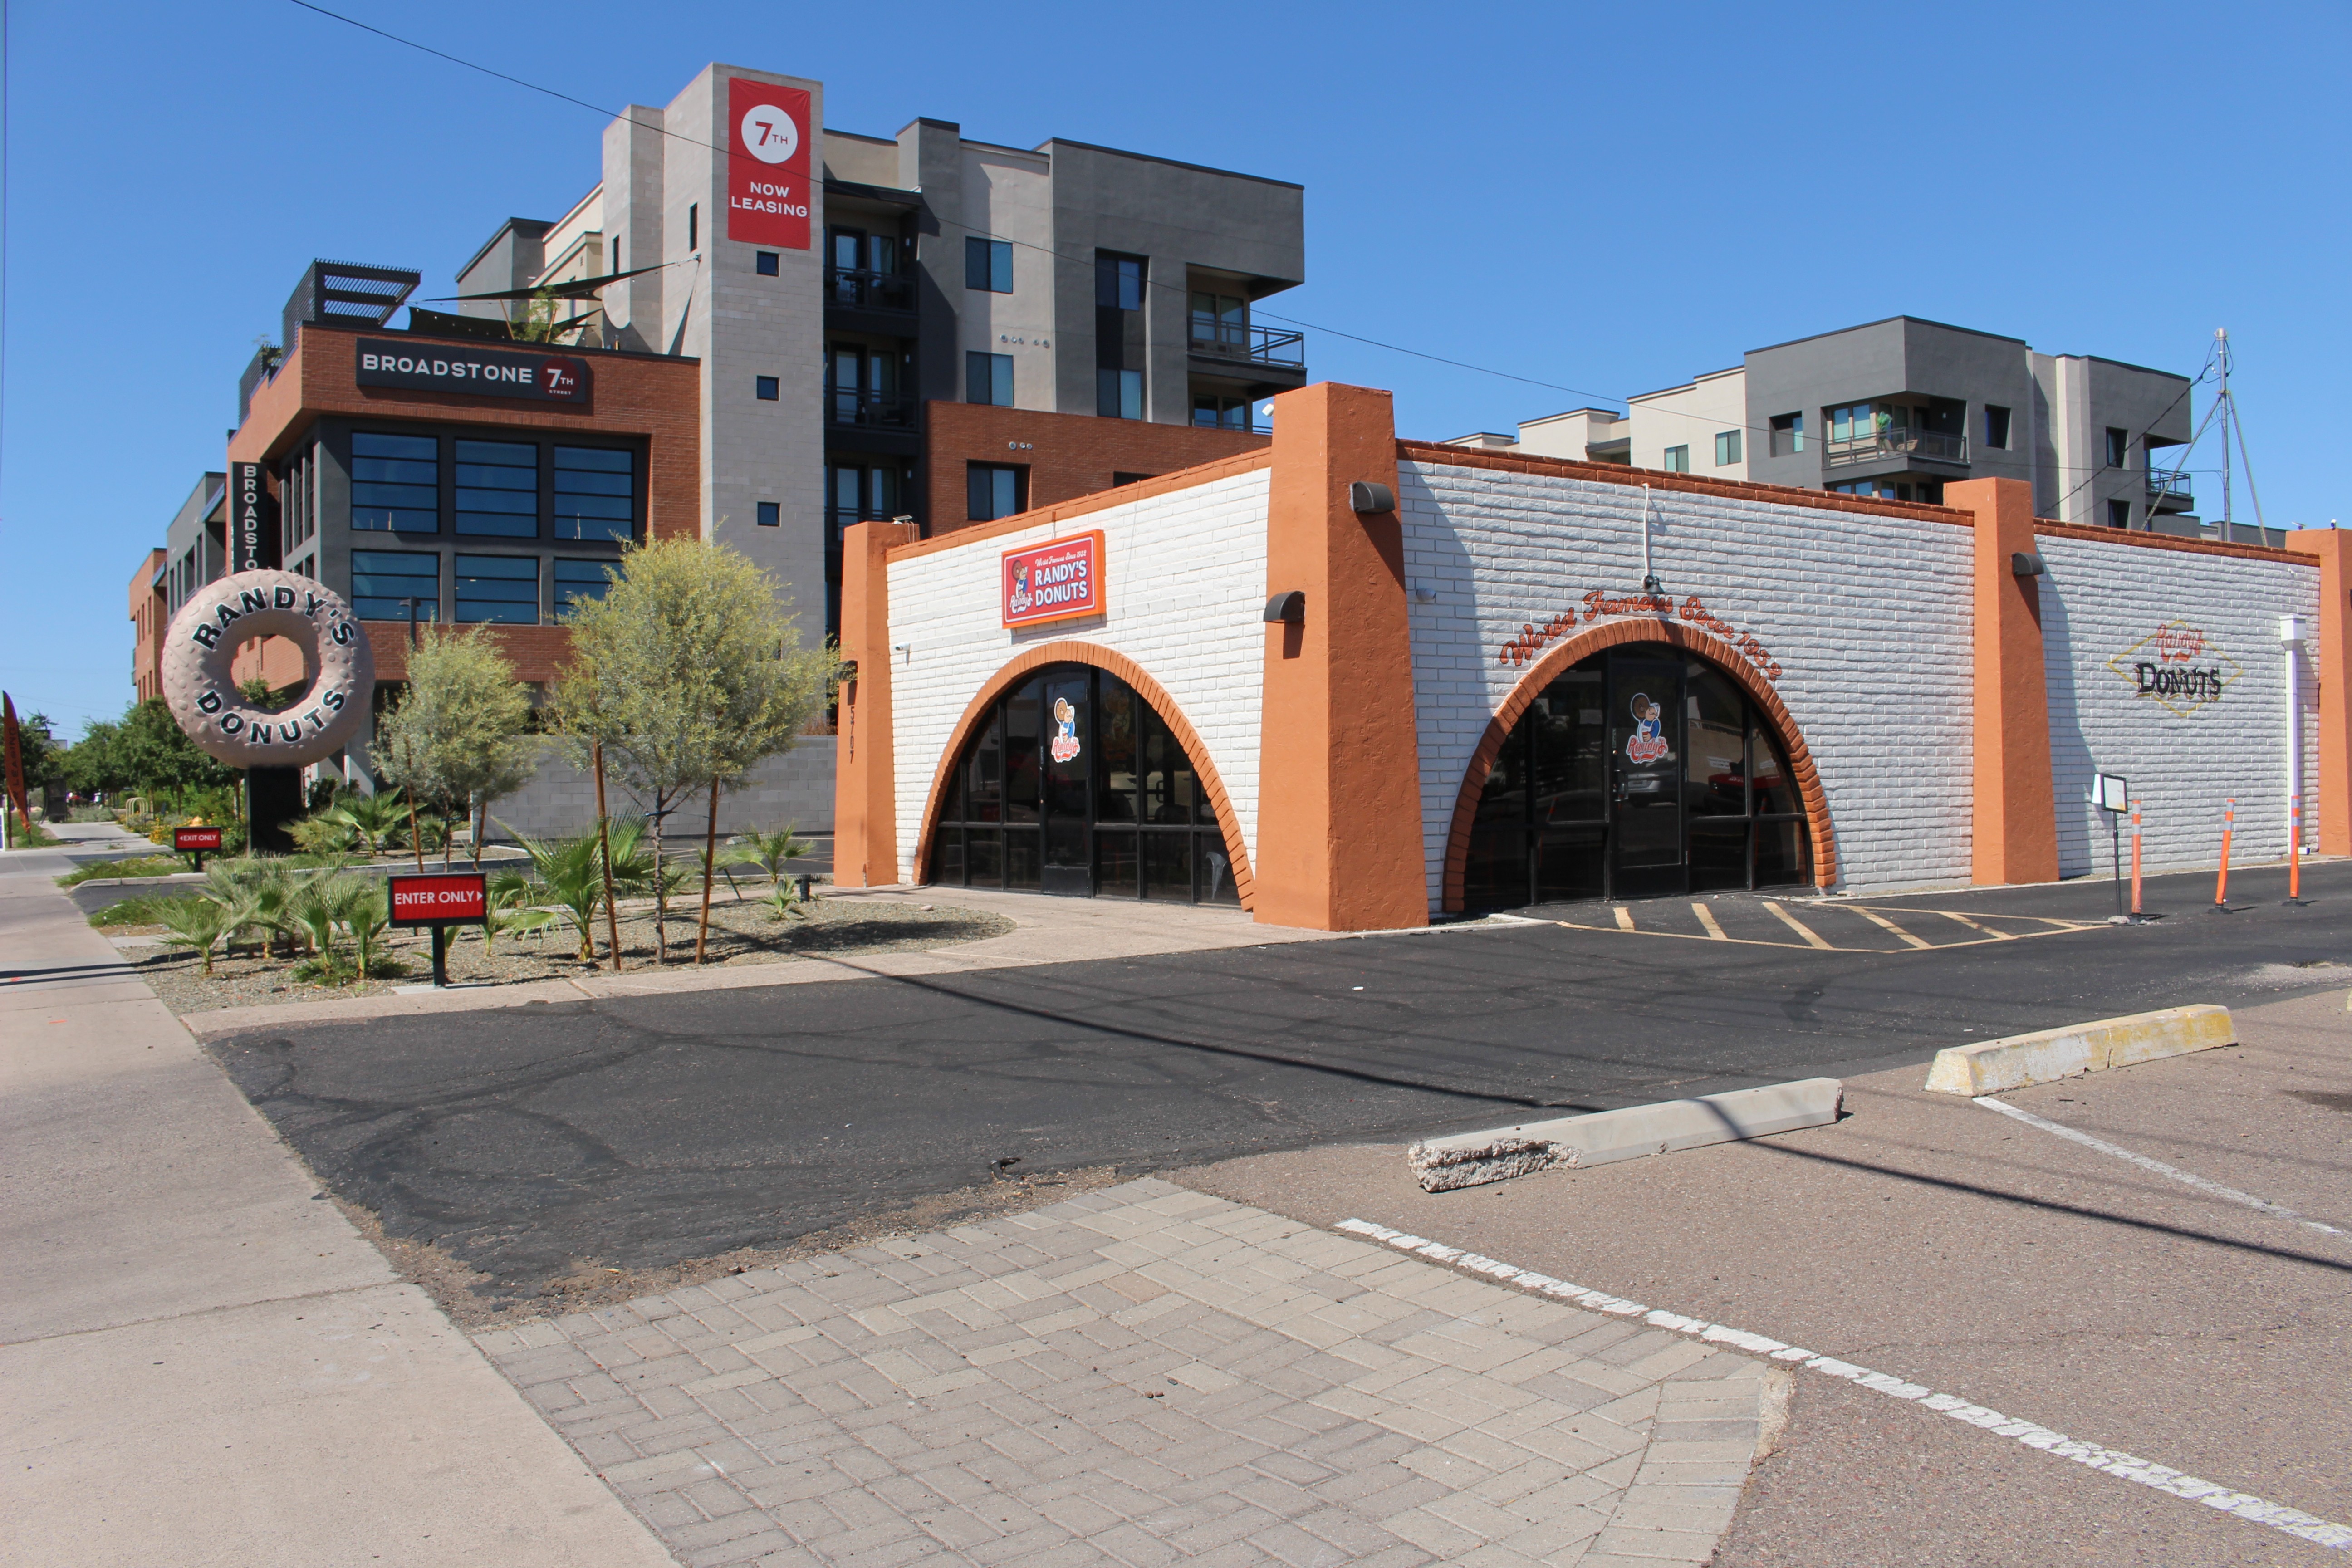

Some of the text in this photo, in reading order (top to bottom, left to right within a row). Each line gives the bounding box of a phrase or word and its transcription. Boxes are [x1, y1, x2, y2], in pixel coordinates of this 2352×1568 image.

[755, 120, 789, 146] 7TH
[750, 181, 790, 198] NOW
[731, 196, 808, 218] LEASING
[363, 353, 574, 388] BROADSTONE 7TH
[1035, 549, 1087, 567] World Famous Since 1952
[1035, 560, 1088, 587] RANDY'S
[1009, 593, 1033, 614] Randy's
[1035, 581, 1088, 607] DONUTS
[191, 585, 355, 651] RANDY'S
[1499, 590, 1783, 681] World Famous Since 1952
[2155, 623, 2206, 663] Randy's
[2134, 662, 2222, 702] DONUTS
[196, 689, 347, 745] DONUTS
[9, 727, 19, 786] LEASING
[1052, 738, 1079, 761] Randy's
[1627, 737, 1668, 762] Randy's
[394, 890, 475, 905] ENTER ONLY
